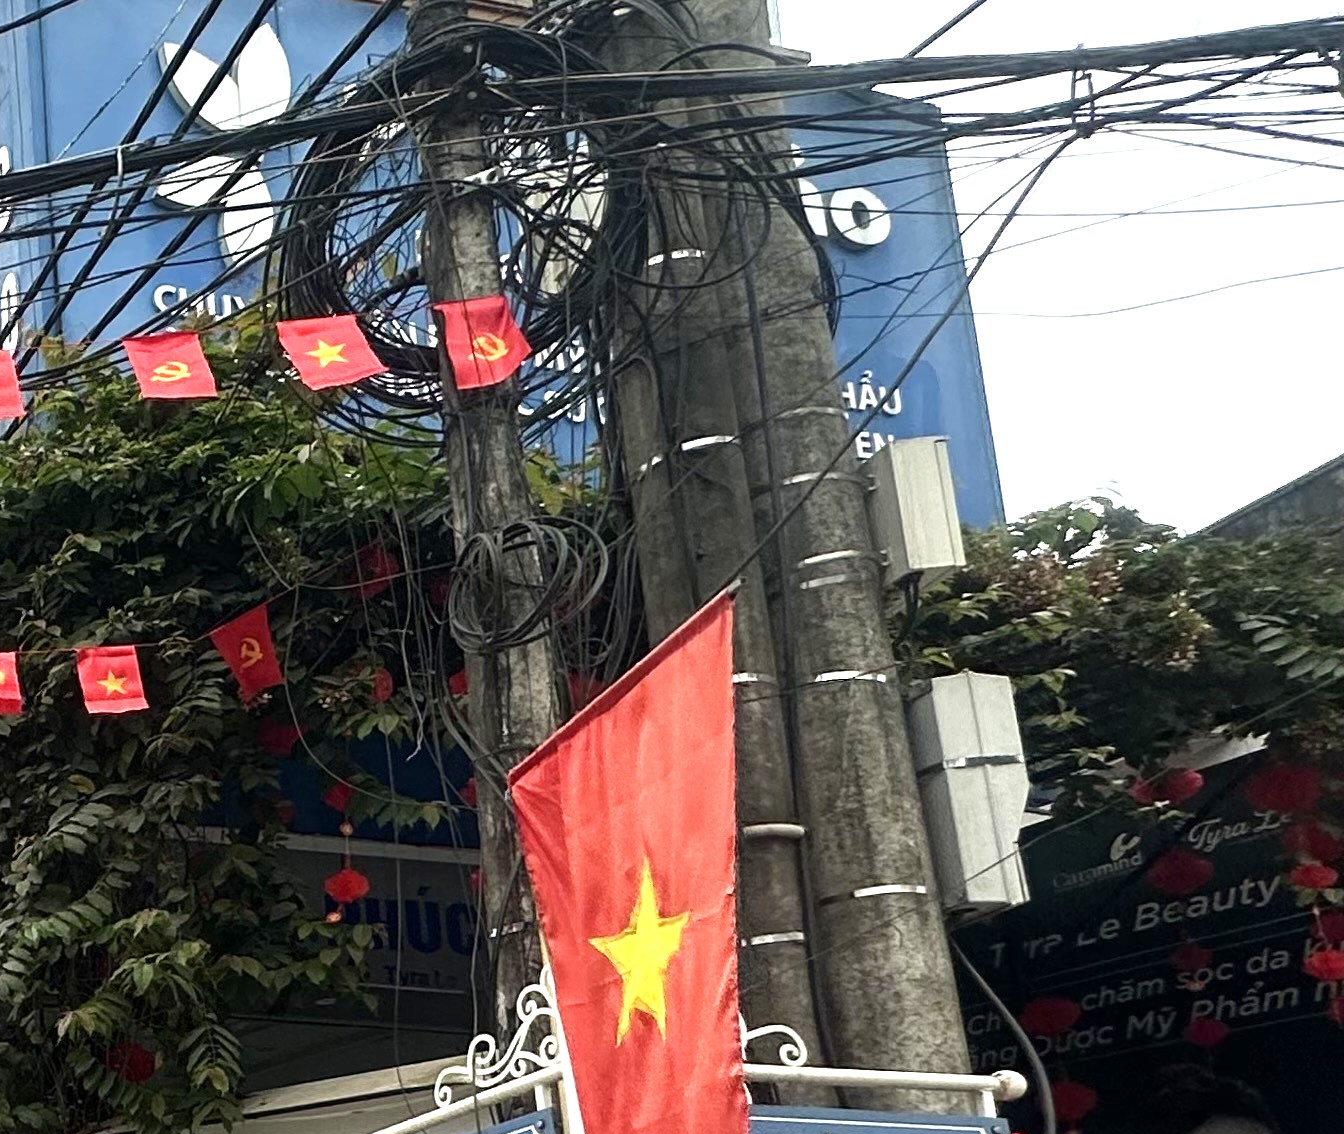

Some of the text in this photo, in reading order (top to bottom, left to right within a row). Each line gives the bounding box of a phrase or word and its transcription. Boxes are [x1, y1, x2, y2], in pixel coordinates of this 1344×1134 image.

[1133, 874, 1281, 932] Beauty
[1246, 948, 1290, 974] da
[1126, 1008, 1176, 1040] Mỹ
